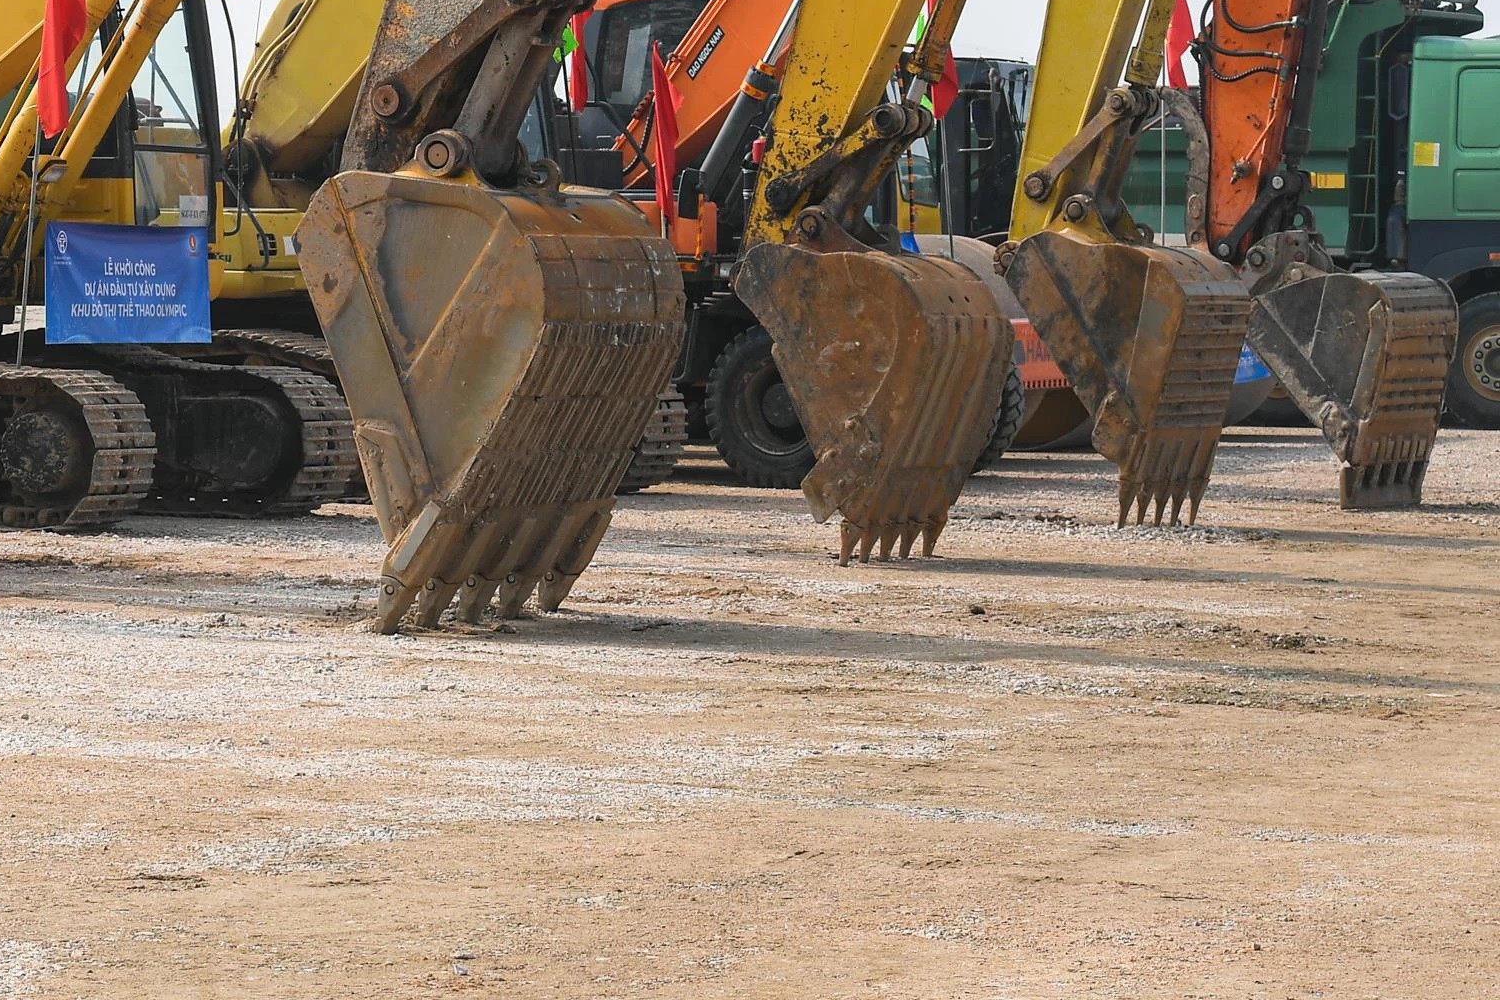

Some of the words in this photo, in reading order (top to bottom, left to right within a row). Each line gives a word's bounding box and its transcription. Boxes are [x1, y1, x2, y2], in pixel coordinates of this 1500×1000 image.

[688, 60, 701, 78] DAO
[697, 43, 713, 65] NGOC
[709, 28, 724, 47] NAM
[104, 256, 114, 276] LỄ
[114, 258, 133, 276] KHỞI
[134, 259, 156, 276] CÔNG
[84, 281, 97, 300] DỰ
[97, 279, 109, 296] ÁN
[110, 277, 126, 297] ĐẦU
[127, 281, 138, 297] TƯ
[138, 280, 154, 297] XÂY
[155, 281, 176, 301] DỰNG
[71, 303, 91, 317] KHU
[92, 300, 103, 317] ĐÔ
[103, 303, 117, 321] THỊ
[118, 297, 134, 317] THỂ
[135, 303, 156, 317] THAO
[156, 303, 187, 317] OLYMPIC
